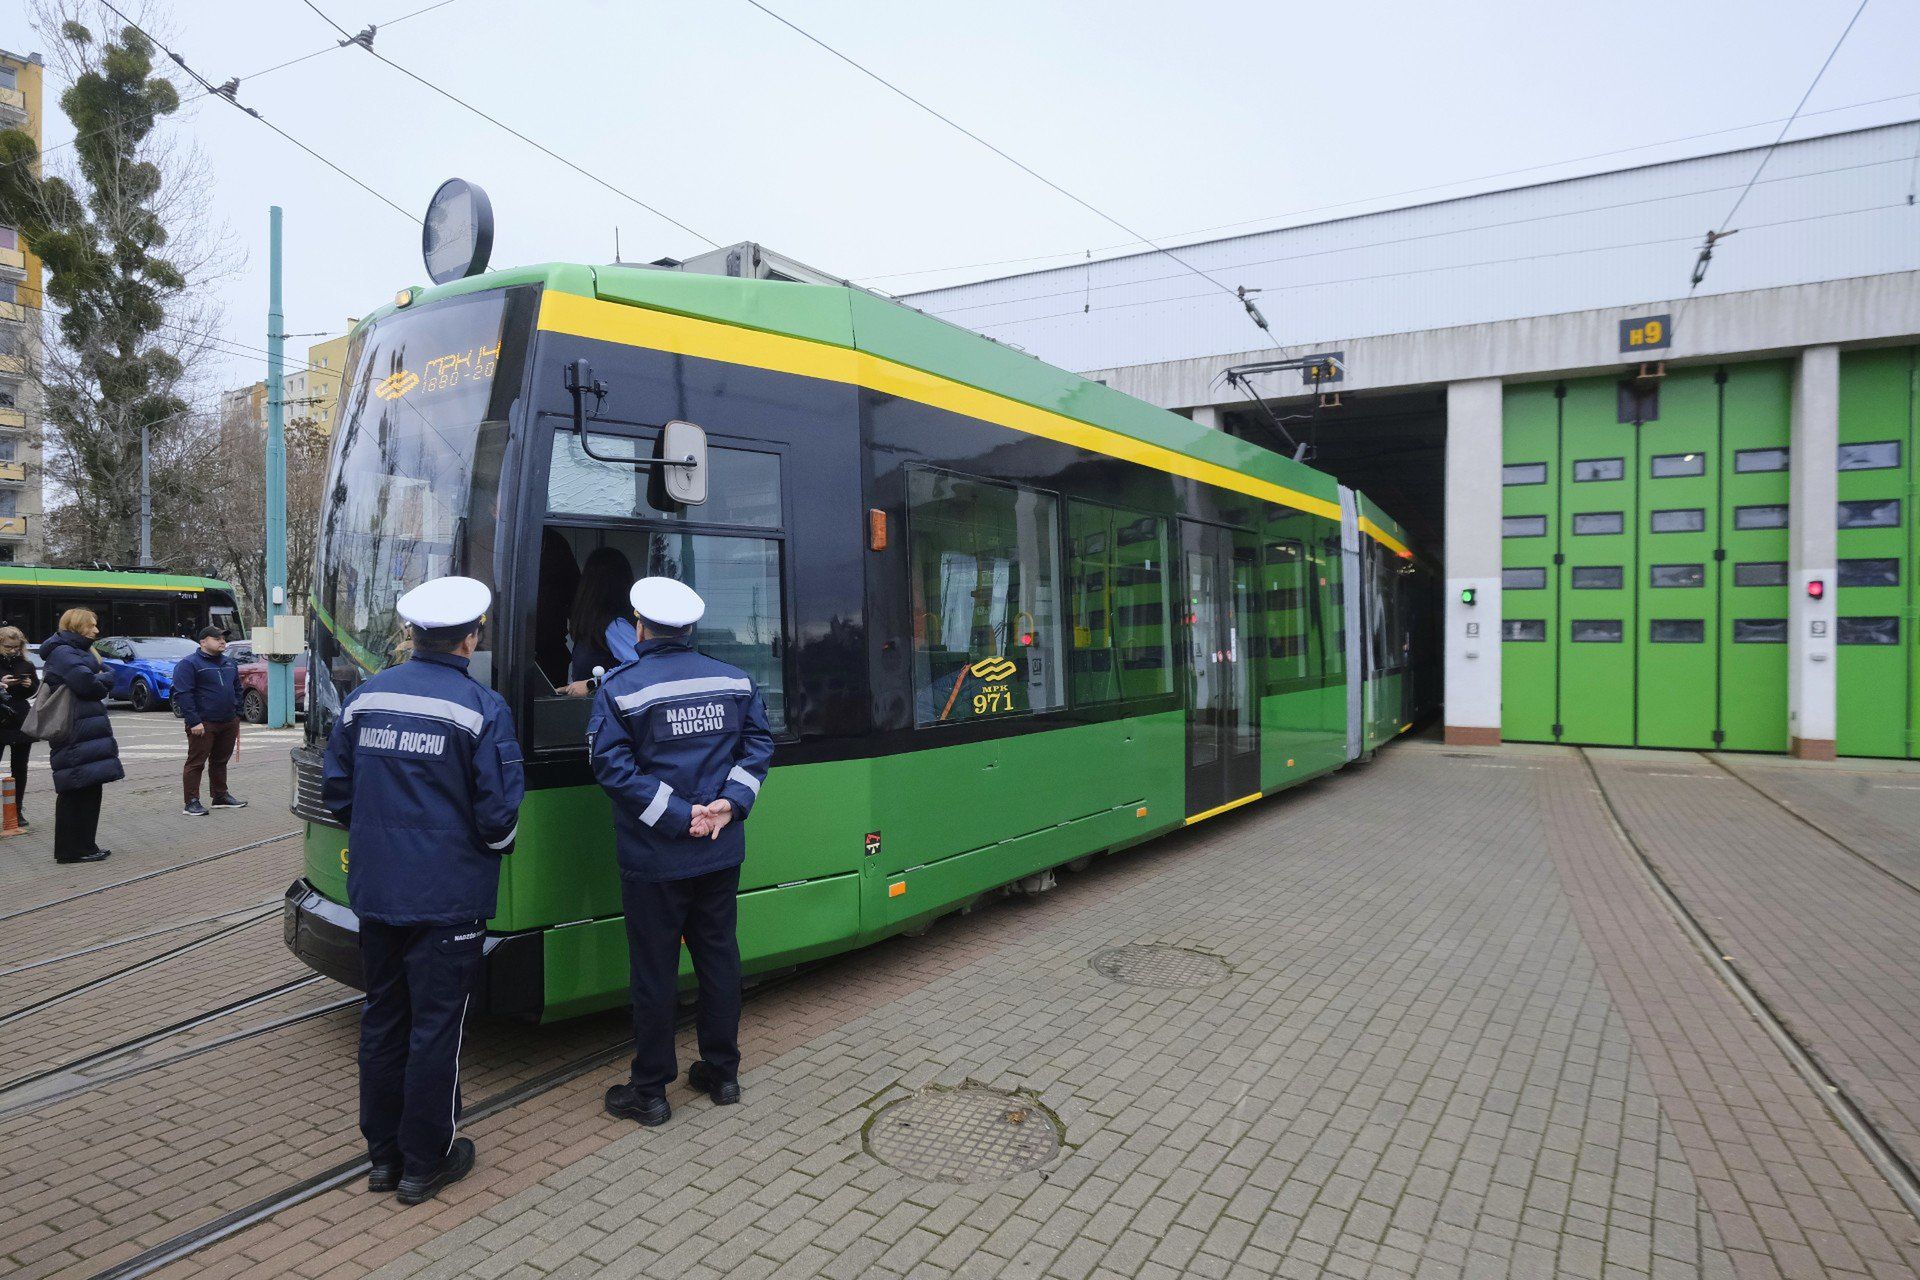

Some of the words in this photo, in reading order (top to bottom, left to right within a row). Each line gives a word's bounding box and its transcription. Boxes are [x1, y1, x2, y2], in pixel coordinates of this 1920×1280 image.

[982, 684, 1009, 693] MPK
[666, 702, 725, 723] NADZÓR
[973, 691, 1014, 714] 971
[671, 717, 724, 736] RUCHU
[359, 723, 398, 750] NADZÓR
[398, 731, 446, 756] RUCHU
